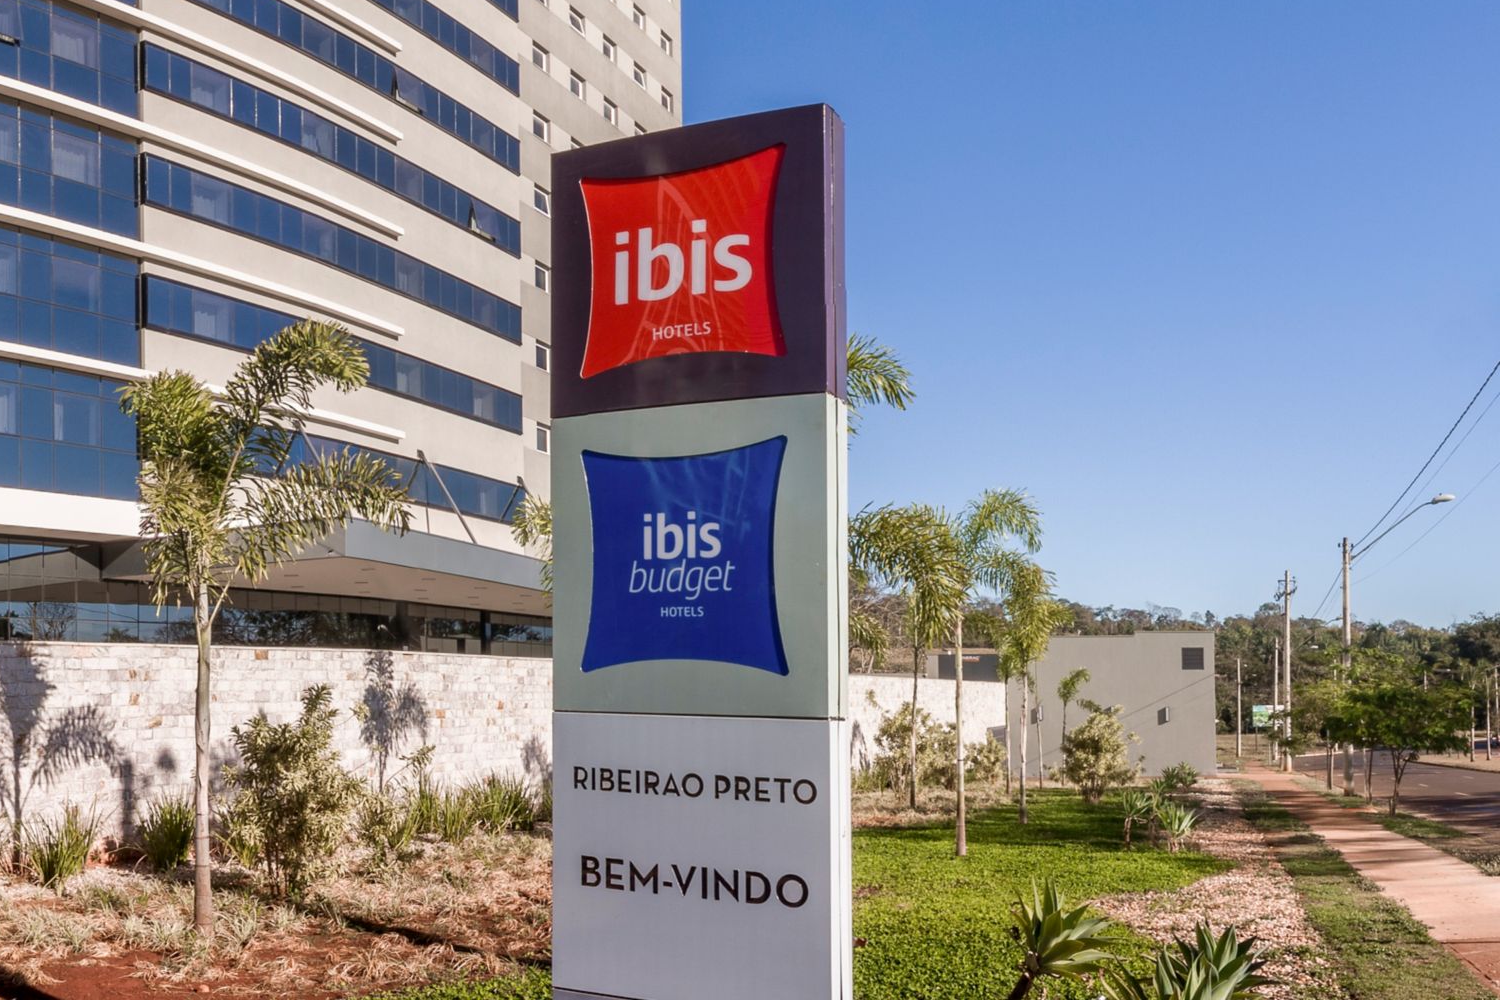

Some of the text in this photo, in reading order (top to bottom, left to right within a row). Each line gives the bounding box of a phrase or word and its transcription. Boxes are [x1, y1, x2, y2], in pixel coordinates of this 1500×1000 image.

[614, 218, 753, 306] ibis
[652, 321, 712, 341] HOTELS
[643, 511, 722, 560] ibis
[628, 558, 736, 600] budget
[660, 606, 704, 618] HOTELS
[573, 766, 817, 805] RIBEIRAO PRETO
[580, 855, 809, 908] BEM-VINDO
